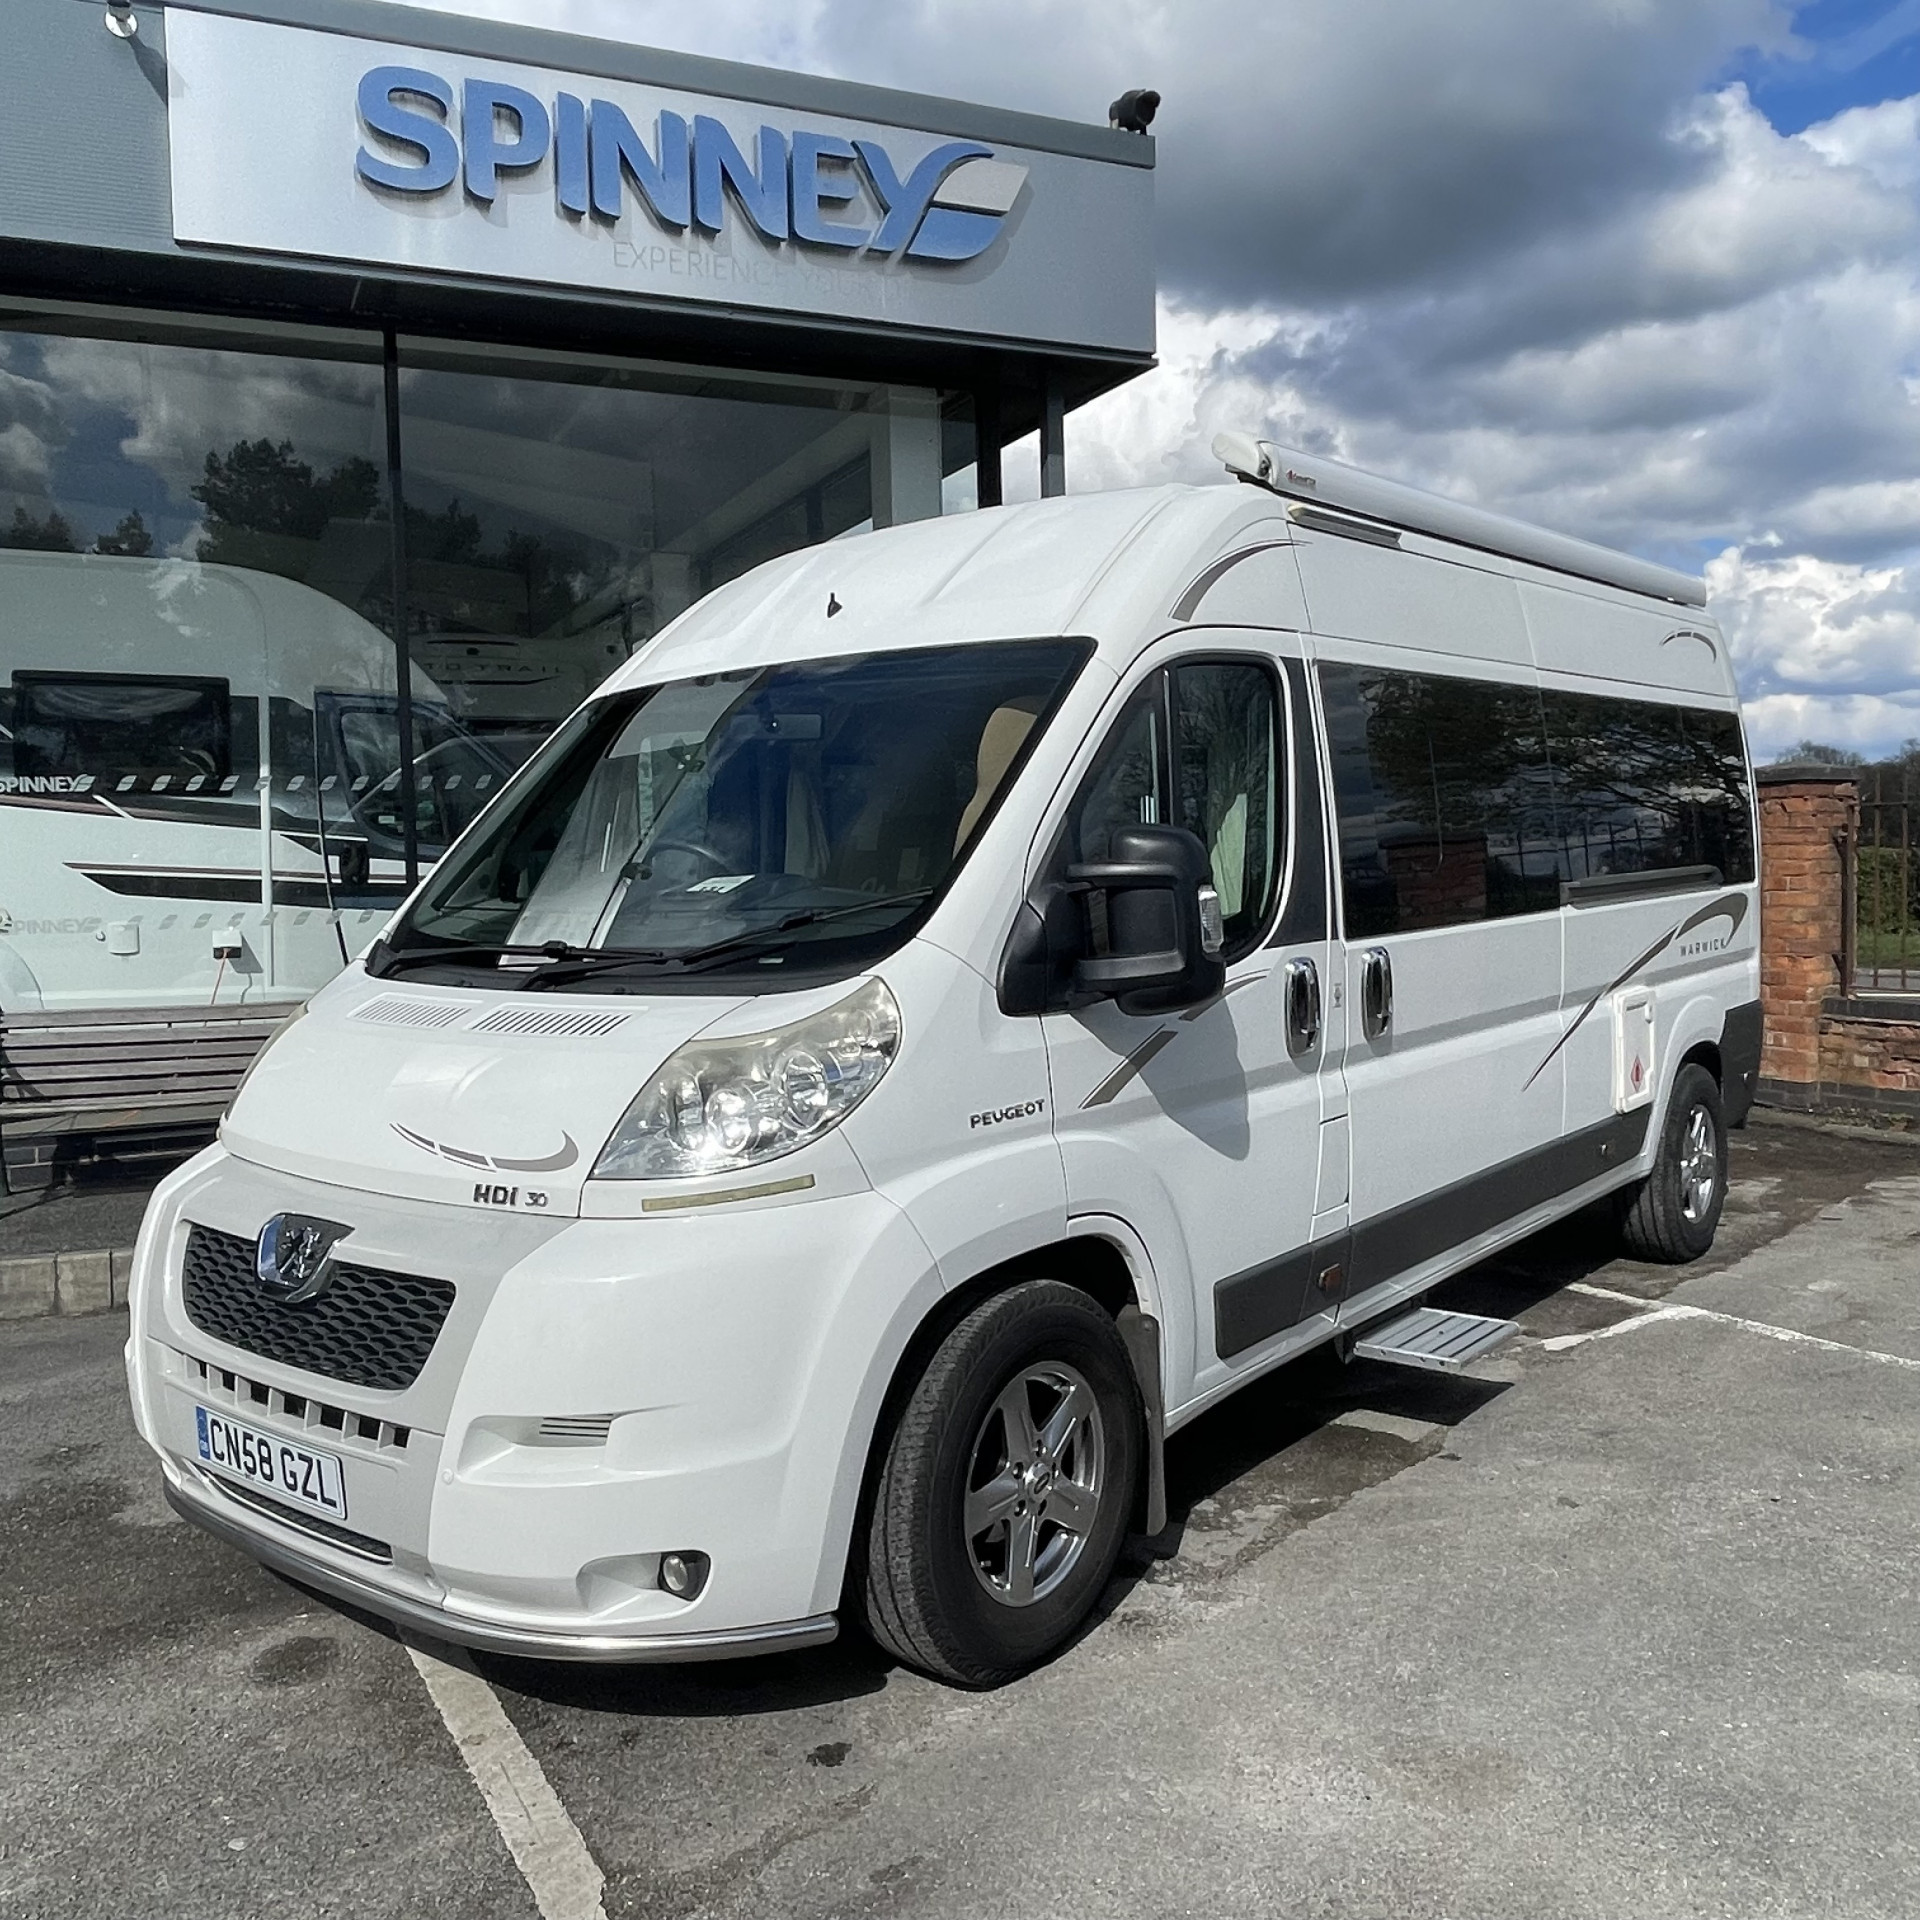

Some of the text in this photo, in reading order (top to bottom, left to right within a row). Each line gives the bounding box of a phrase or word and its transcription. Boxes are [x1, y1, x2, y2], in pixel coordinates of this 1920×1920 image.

[356, 65, 1000, 262] SPINNEY
[612, 241, 787, 286] EXPERIENCE
[1680, 937, 1728, 957] WARWICK
[970, 1099, 1045, 1129] PEUGEOT
[473, 1184, 519, 1206] HDI
[210, 1418, 338, 1509] CN58 GZL
